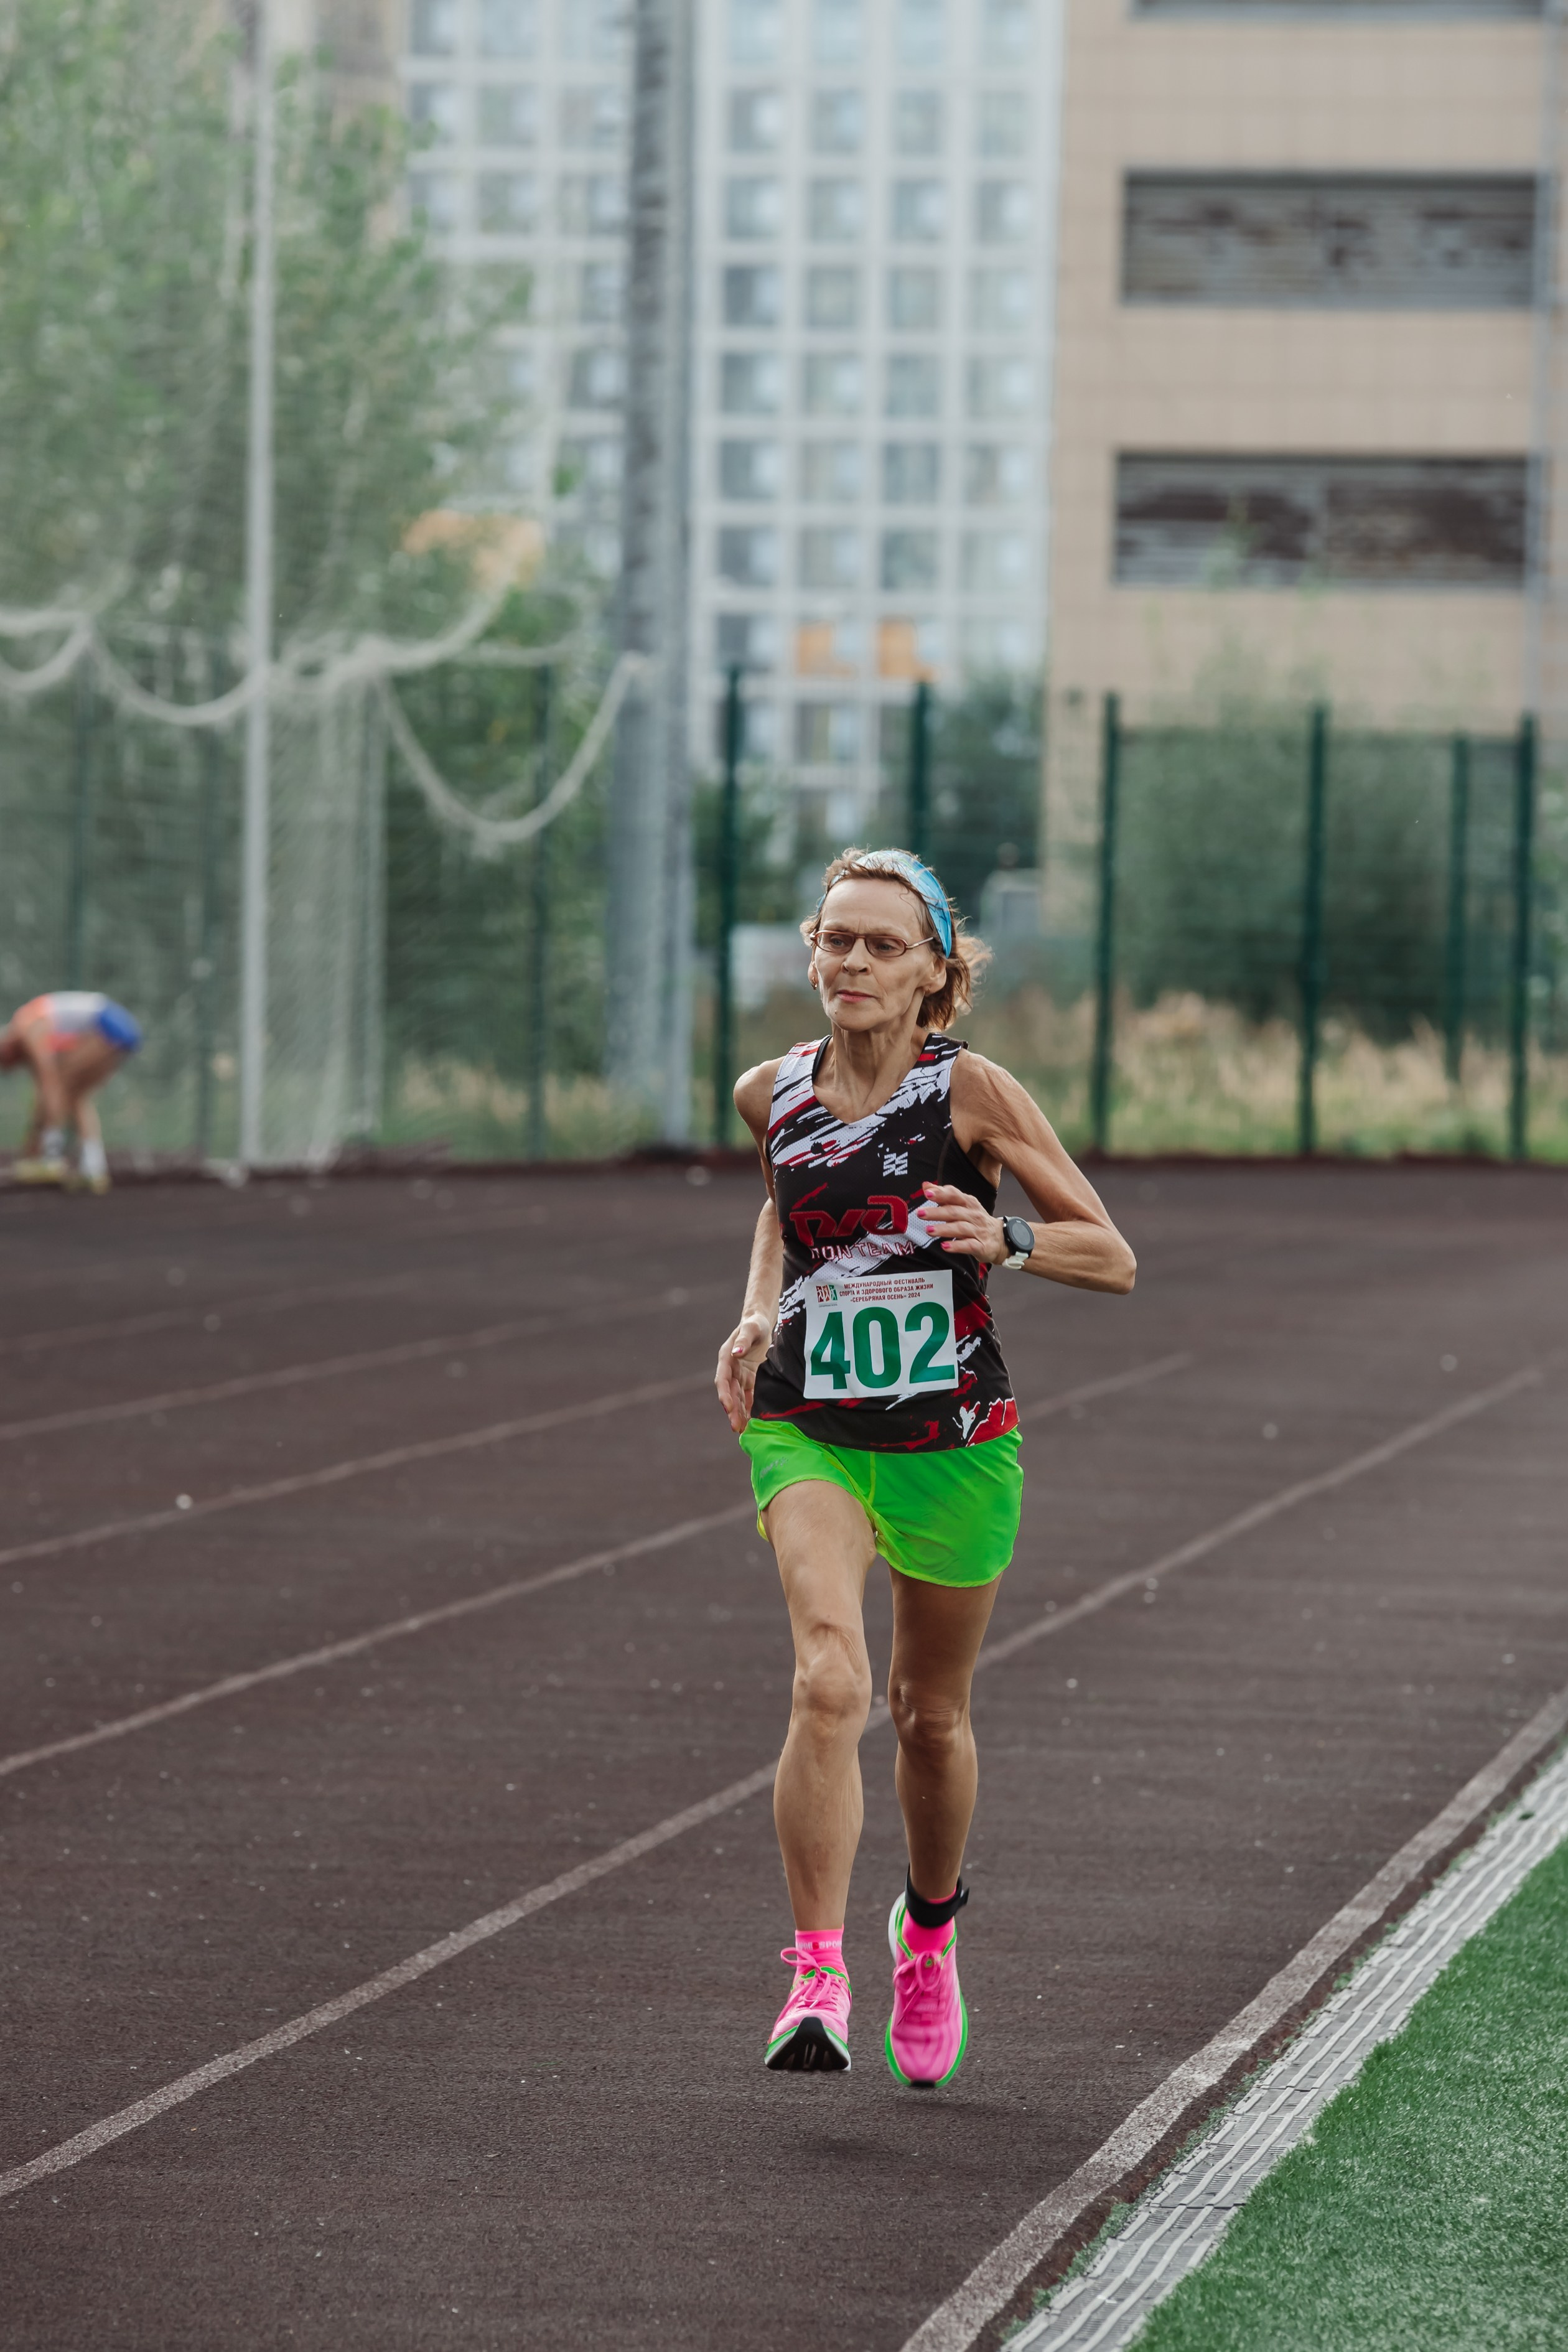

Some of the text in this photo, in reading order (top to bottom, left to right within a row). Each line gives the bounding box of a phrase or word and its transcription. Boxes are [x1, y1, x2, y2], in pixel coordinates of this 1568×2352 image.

[854, 1239, 915, 1256] TEAM
[844, 1279, 892, 1289] МЕЖДУНАРОДНЫЙ
[811, 1302, 956, 1389] 402
